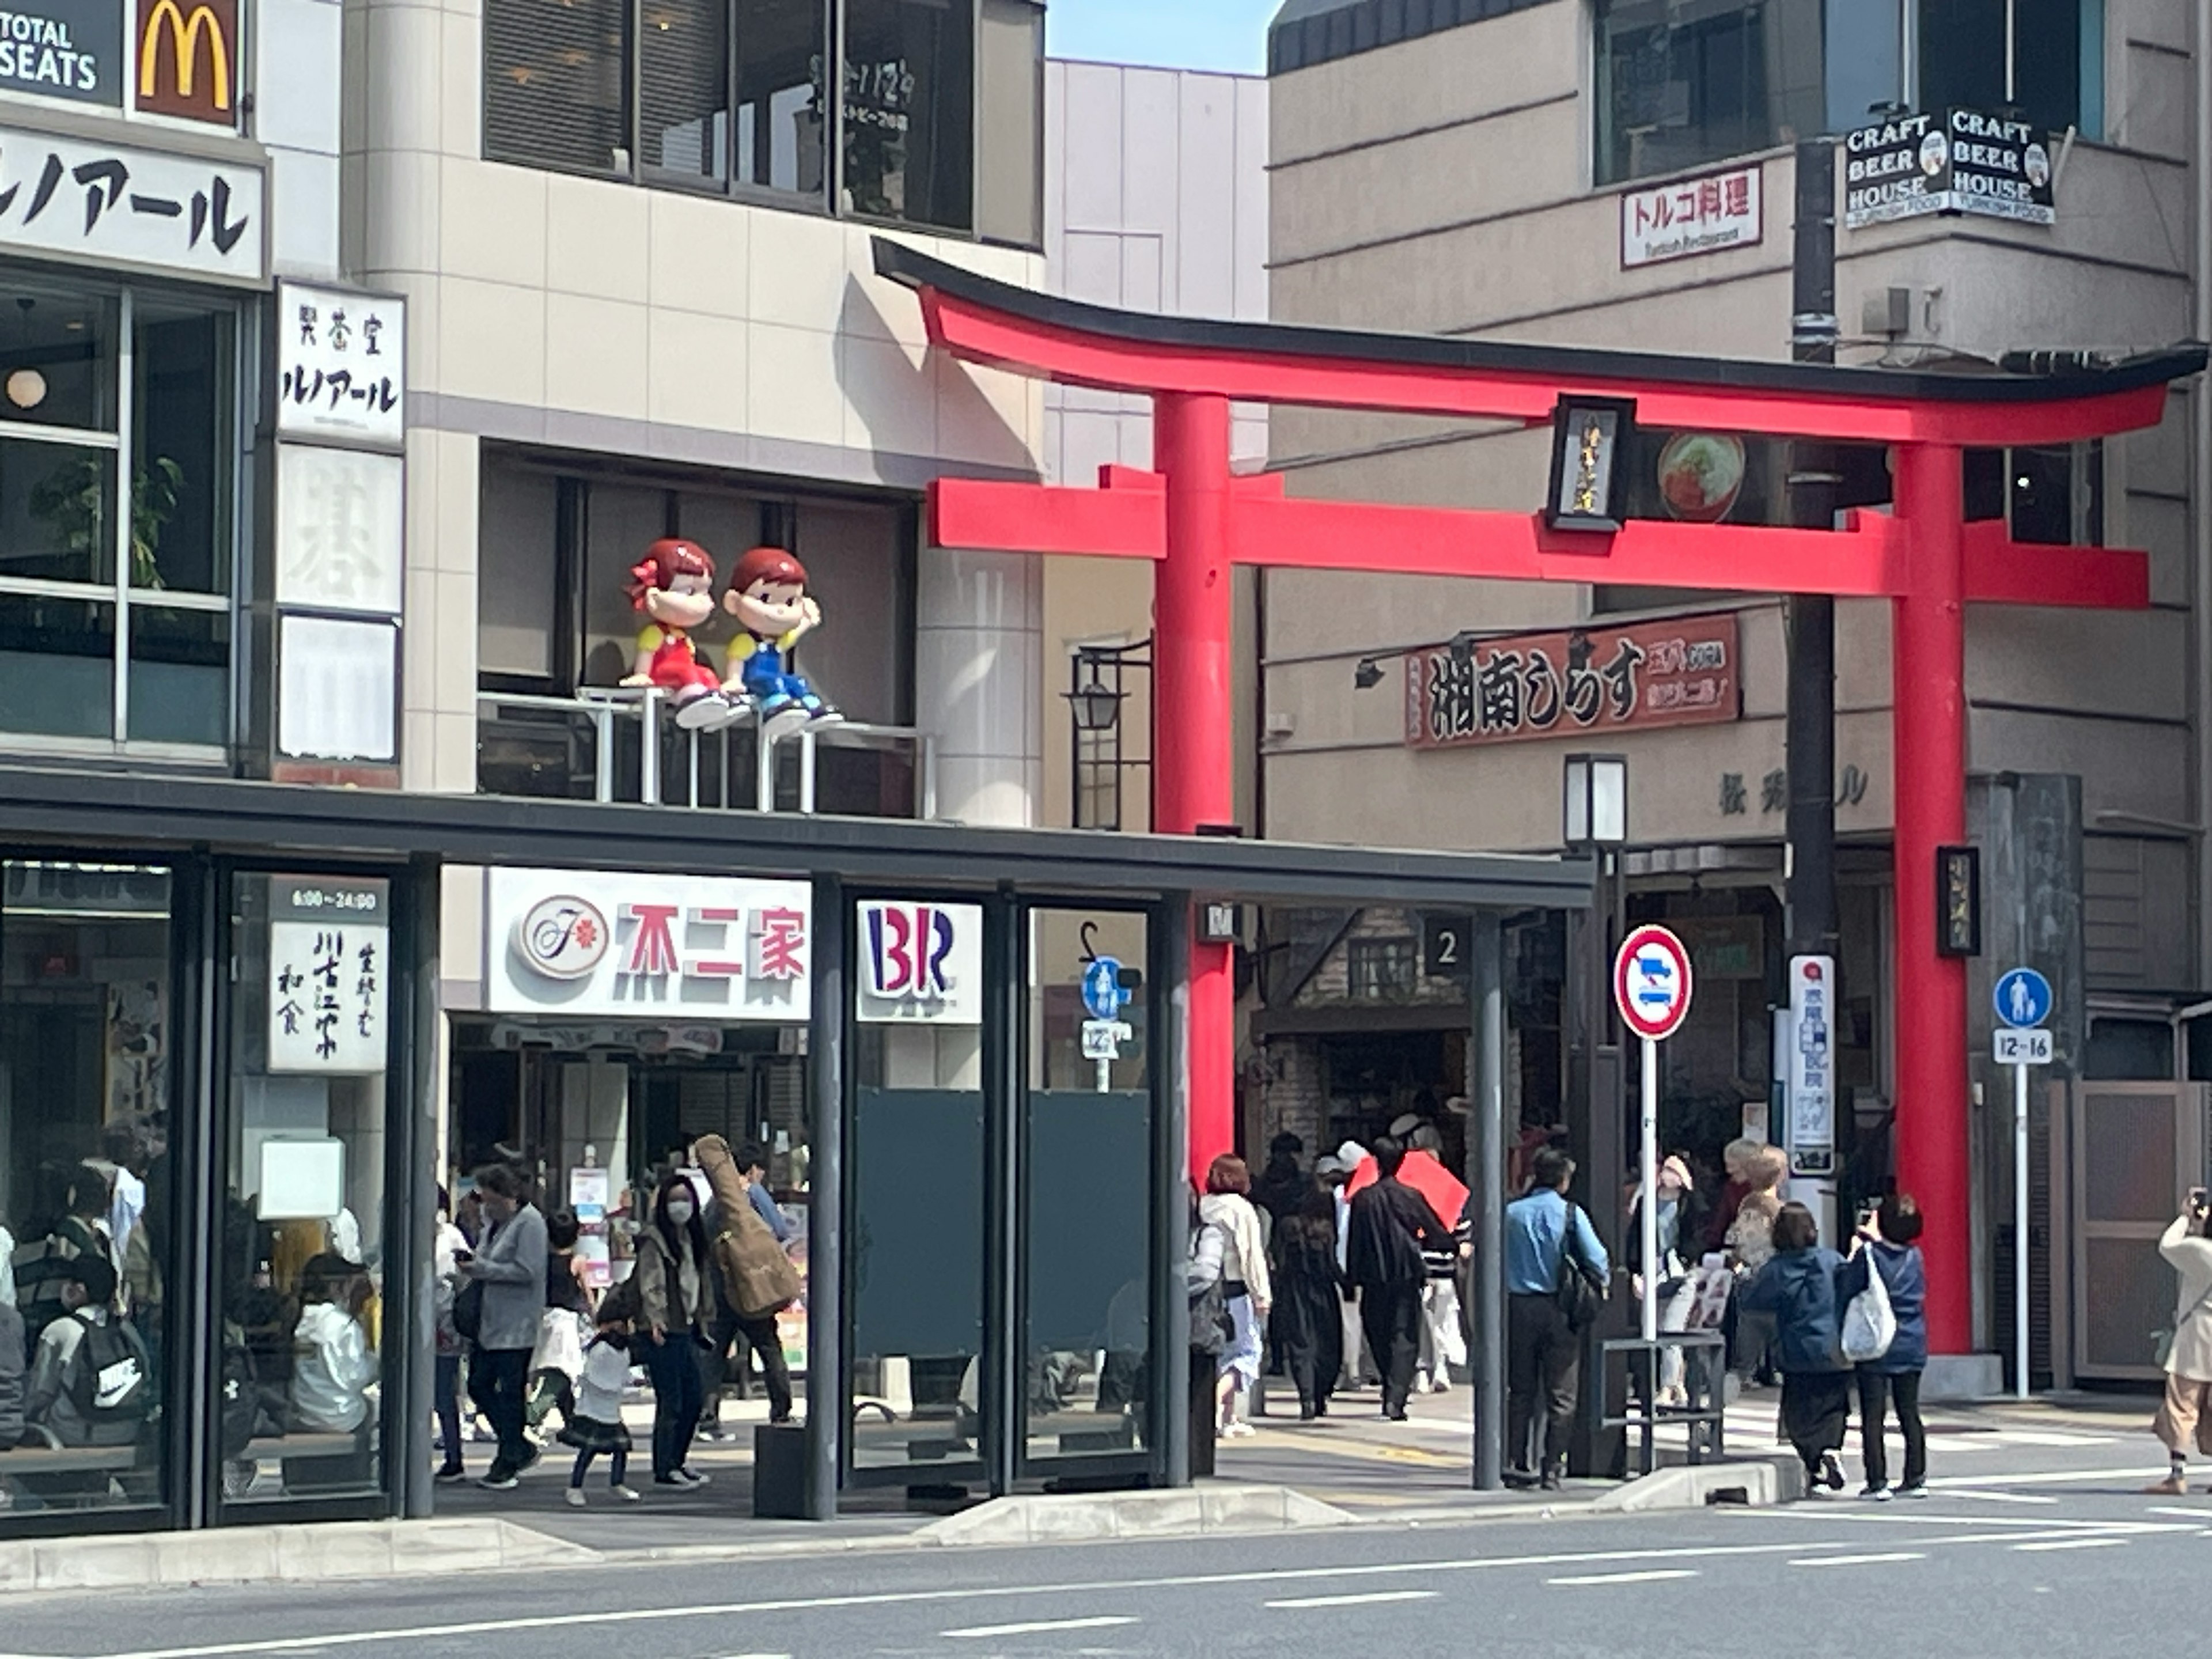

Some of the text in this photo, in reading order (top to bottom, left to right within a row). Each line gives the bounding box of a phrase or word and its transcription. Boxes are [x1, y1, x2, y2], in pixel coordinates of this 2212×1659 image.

[0, 12, 73, 48] TOTAL
[0, 41, 96, 90] SEATS
[1847, 115, 1930, 152] CRAFT
[1953, 111, 2032, 144] CRAFT
[1849, 149, 1914, 182] BEER
[1954, 141, 2019, 173] BEER
[0, 152, 248, 255] ノアール
[1849, 175, 1929, 211] HOUSE
[1954, 171, 2034, 203] HOUSE
[1635, 176, 1749, 238] トルコ料理
[282, 363, 400, 414] ルノアール
[1429, 637, 1646, 740] 湘南しらす
[630, 903, 805, 979] 不二家
[1439, 931, 1458, 963] 2
[276, 963, 304, 1035] 和食
[1999, 1037, 2048, 1057] 12-16
